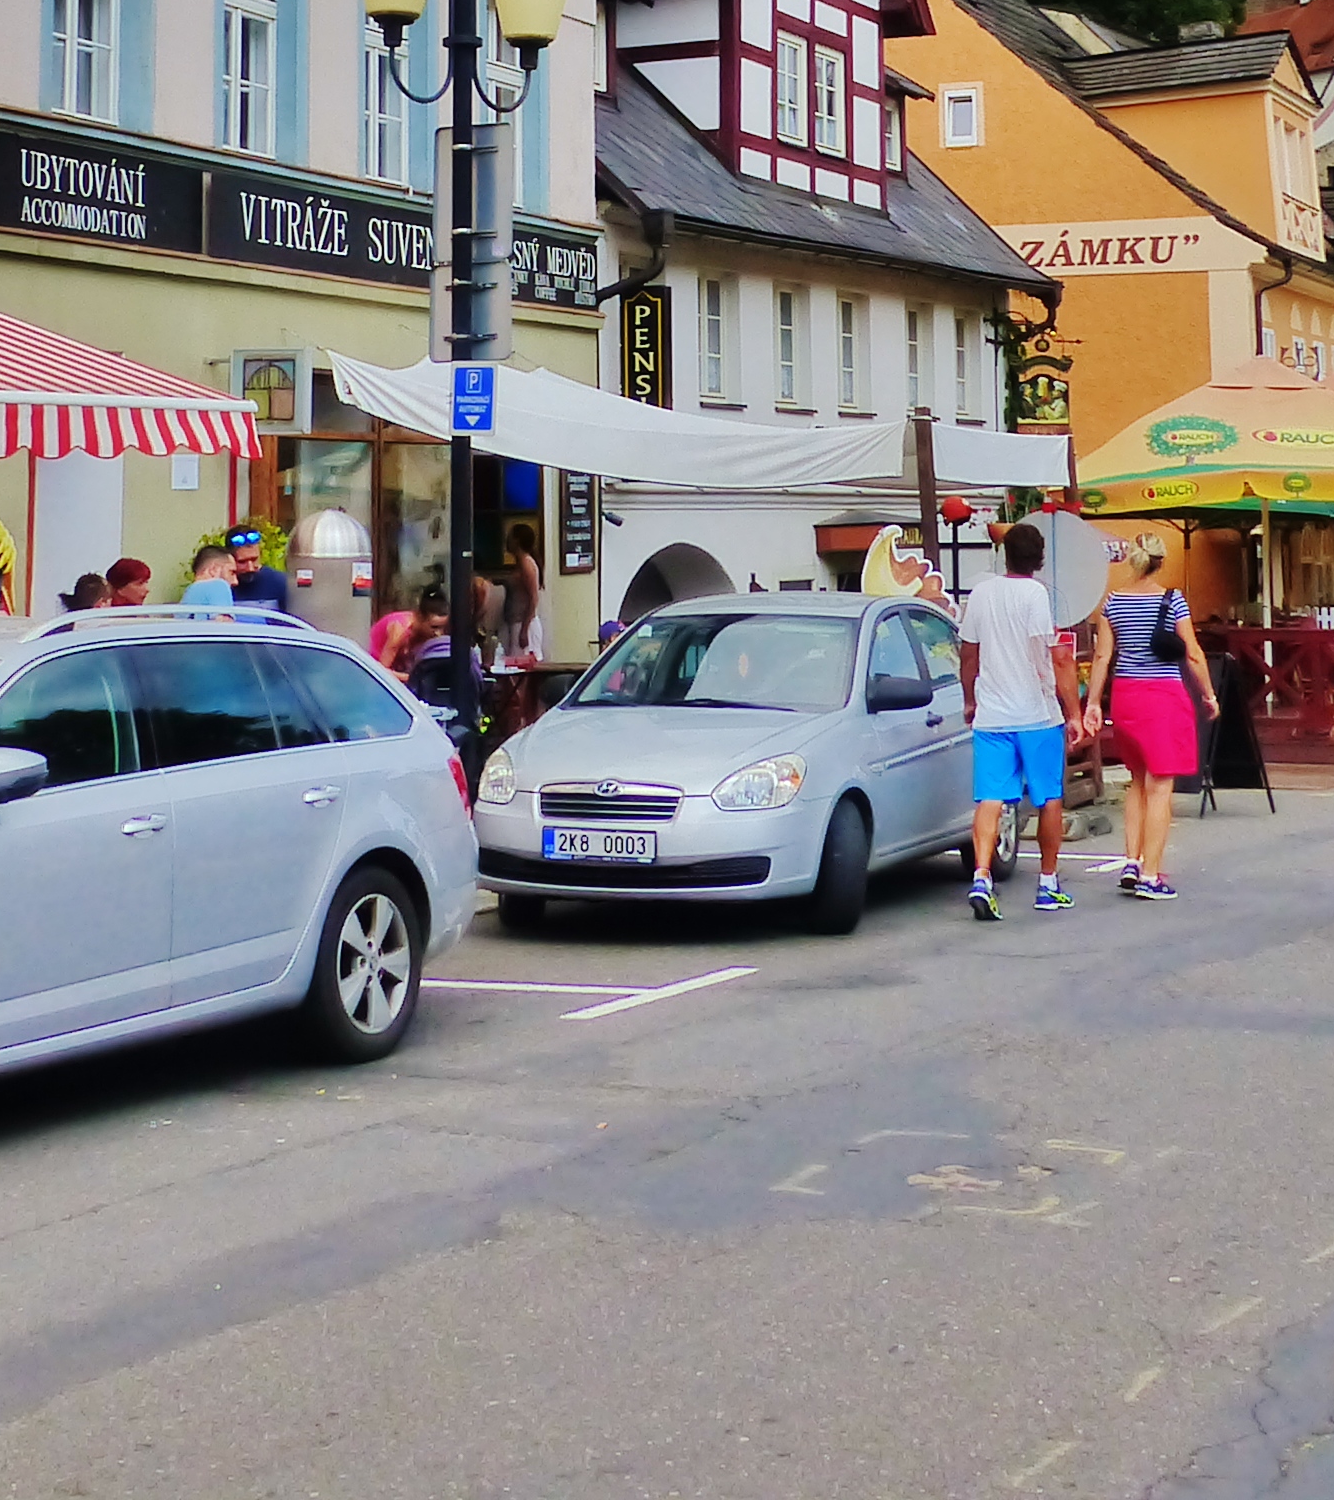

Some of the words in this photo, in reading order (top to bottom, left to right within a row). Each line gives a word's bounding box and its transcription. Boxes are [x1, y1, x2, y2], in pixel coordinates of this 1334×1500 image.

[20, 148, 146, 208] UBYTOVÁNÍ
[20, 195, 147, 240] ACCOMMODATION
[240, 191, 349, 257] VITRÁŽE
[368, 217, 434, 271] SUVEN
[546, 245, 596, 281] MEDVĚD
[632, 304, 655, 404] PENS
[469, 372, 479, 390] P
[1178, 432, 1215, 442] RAUCH
[1155, 481, 1194, 498] RAUCH
[558, 833, 589, 853] 2K8
[603, 835, 646, 855] 0003
